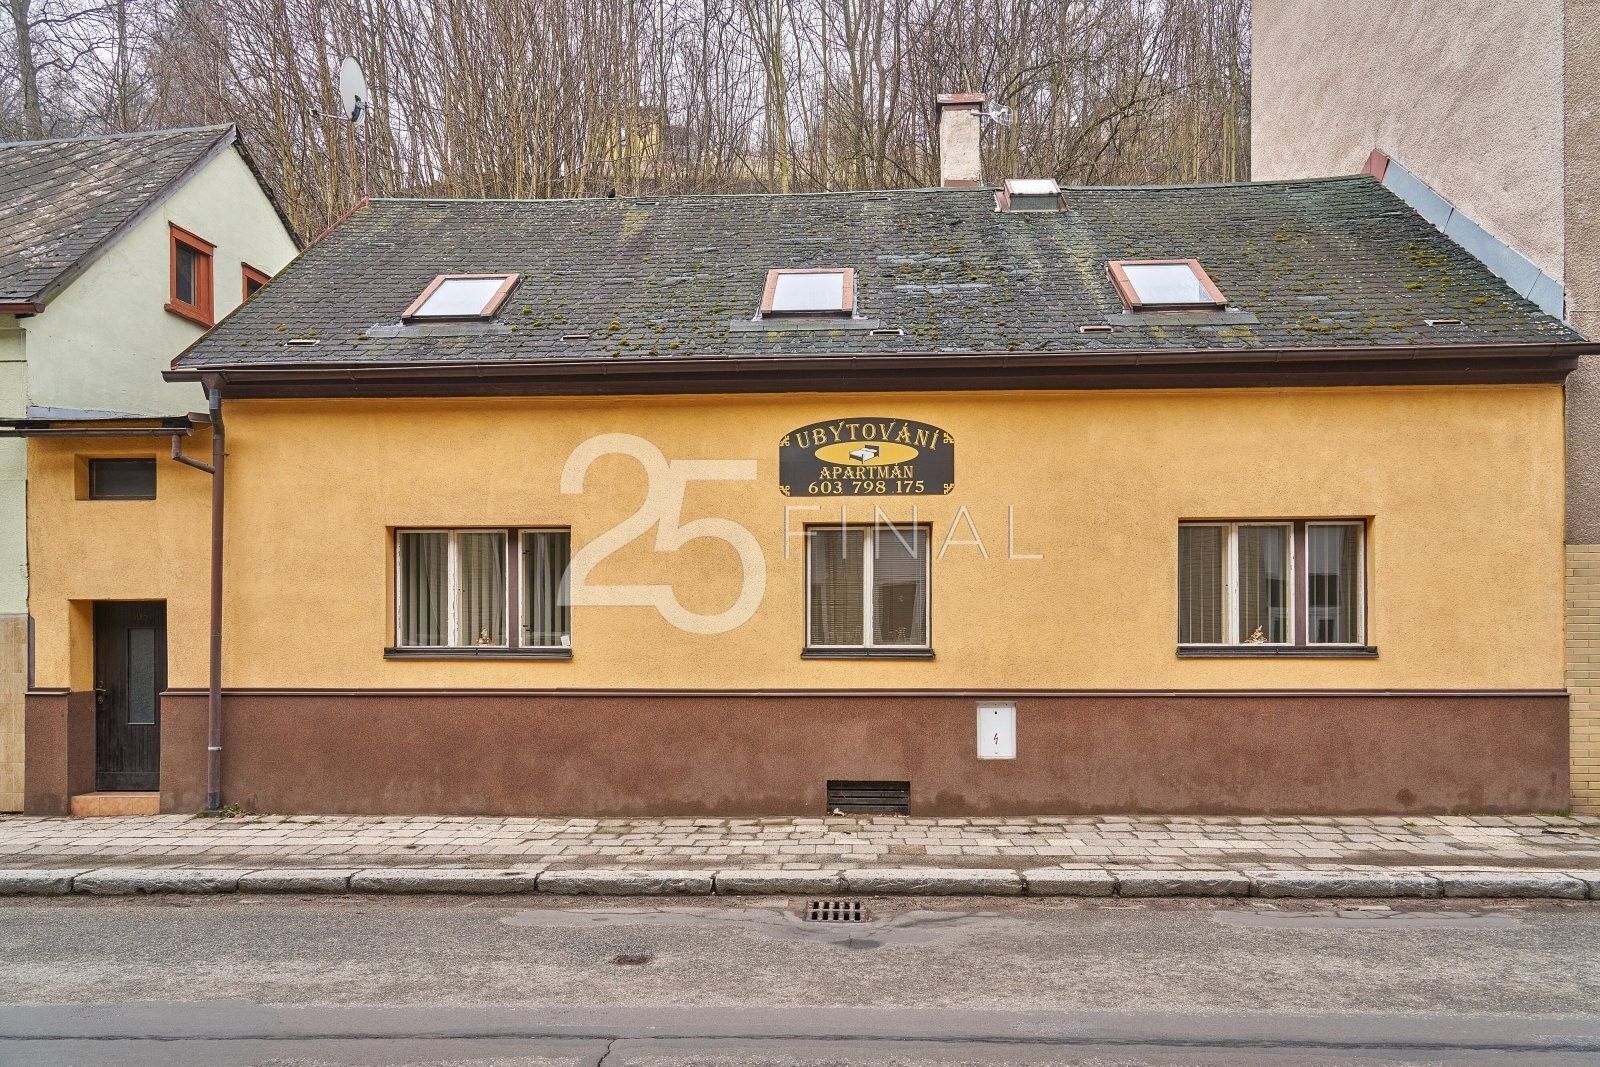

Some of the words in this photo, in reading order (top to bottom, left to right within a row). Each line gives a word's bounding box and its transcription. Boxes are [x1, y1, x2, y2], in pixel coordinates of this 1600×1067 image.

[820, 464, 914, 480] APARTMÁN
[808, 481, 843, 494] 603
[852, 481, 886, 494] 798
[896, 480, 925, 493] 175
